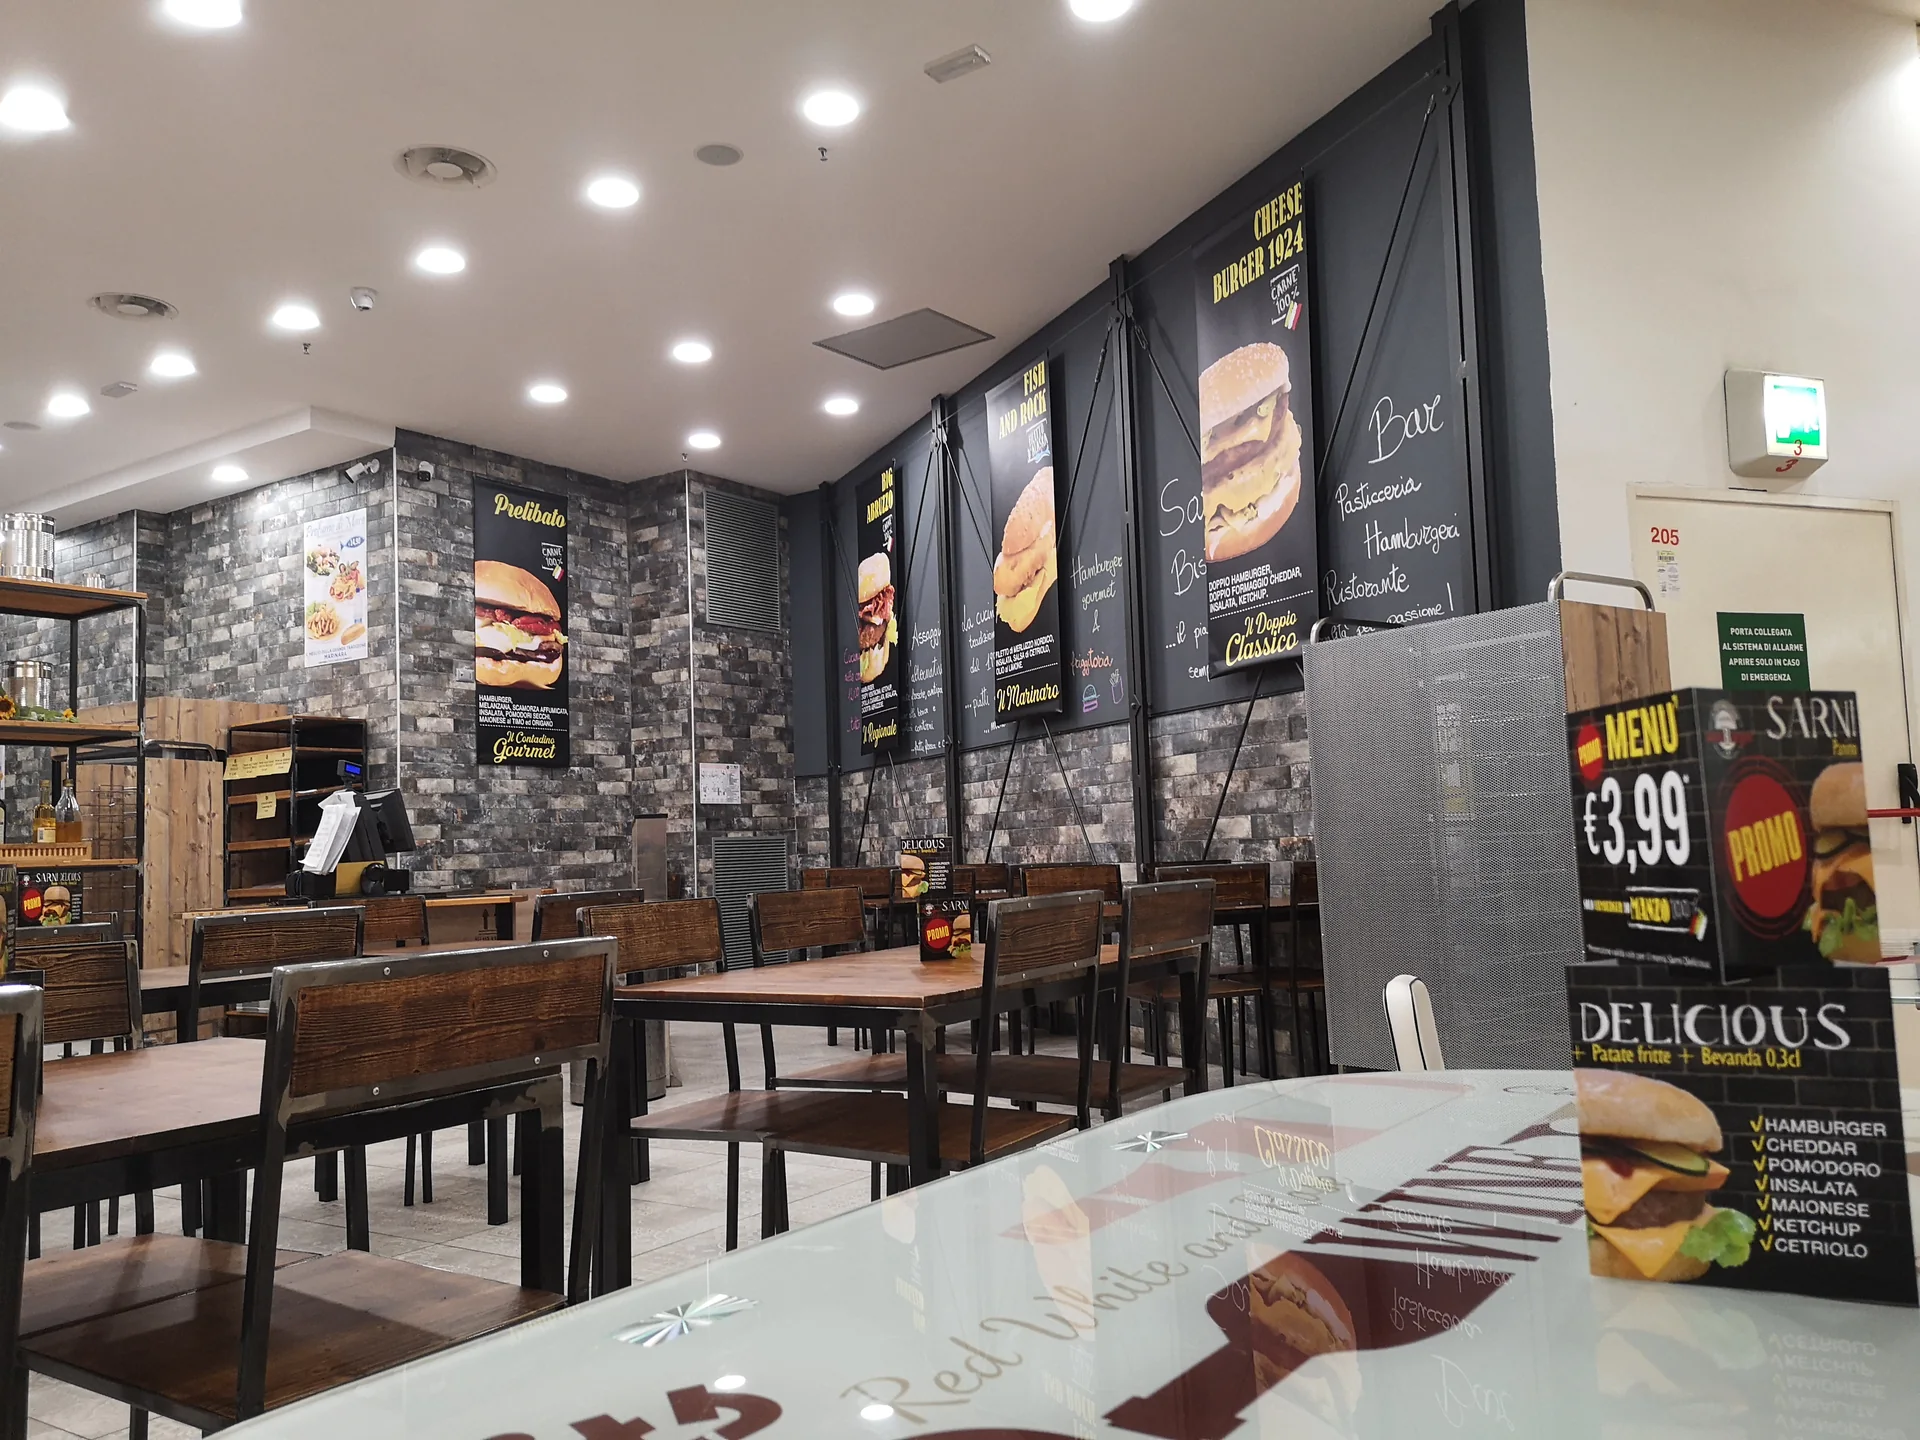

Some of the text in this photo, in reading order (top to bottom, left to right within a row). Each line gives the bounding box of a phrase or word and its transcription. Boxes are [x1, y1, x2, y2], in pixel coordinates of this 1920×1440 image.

[1254, 182, 1302, 240] CHEESE
[1213, 220, 1303, 304] BURGER 1924
[1271, 269, 1298, 300] CARNE
[1023, 361, 1046, 396] FISH
[999, 408, 1018, 440] AND
[1020, 388, 1047, 427] ROCK
[1368, 395, 1444, 463] Bar
[1793, 439, 1803, 455] 3
[1776, 458, 1798, 473] 3
[881, 467, 893, 492] BIG
[494, 493, 566, 528] Prelibato
[867, 490, 894, 524] ABRUZZO
[1159, 478, 1204, 536] Sa
[1335, 476, 1422, 521] Pasticceria
[1650, 526, 1679, 546] 205
[541, 547, 562, 556] CARNE
[1070, 553, 1122, 589] Hamburger
[1171, 549, 1207, 596] Bis
[1208, 564, 1272, 592] DOPPIO HAMBURGER,
[1209, 566, 1302, 602] DOPPIO FORMAGGIO CHEDDAR,
[1082, 580, 1116, 610] gourmet
[1323, 563, 1409, 610] Ristorante
[976, 601, 994, 625] cucin
[1209, 588, 1269, 614] INSALATA, KETCHUP.
[1386, 604, 1445, 624] passione
[1194, 623, 1208, 650] pia
[1244, 610, 1299, 637] Il Doppio
[1730, 627, 1792, 636] PORTA COLLEGATA
[969, 630, 995, 649] tradizion
[1225, 632, 1299, 667] Classico
[1722, 642, 1804, 652] AL SISTEMA DI ALLARME
[1729, 658, 1800, 667] APRIRE SOLO IN CASO
[1741, 673, 1791, 682] DI EMERGENZA
[479, 694, 513, 704] HAMBURGER,
[479, 702, 568, 716] MELANZANA, SCAMORZA AFFUMICATA,
[1007, 683, 1060, 711] Marinaro
[479, 709, 551, 721] INSALATA, POMODORI SECCHI,
[479, 716, 506, 724] MAIONESE
[512, 718, 524, 726] TIMO
[532, 719, 553, 727] ORIGANO
[1766, 695, 1857, 740] SARNI
[506, 730, 555, 745] Il Contadino
[868, 718, 897, 748] Regionale
[493, 737, 556, 764] Gourmet
[901, 838, 945, 850] DELICIOUS
[1727, 811, 1802, 882] PROMO
[941, 900, 970, 912] SARNI
[926, 925, 949, 942] PROMO
[1579, 1002, 1851, 1050] DELICIOUS
[1591, 1044, 1634, 1063] Patate
[1637, 1046, 1672, 1065] fritte
[1701, 1047, 1762, 1067] Bevanda
[1766, 1048, 1801, 1070] 0,3cl
[1765, 1118, 1887, 1137] HAMBURGER
[1766, 1138, 1858, 1156] CHEDDAR
[1768, 1158, 1881, 1177] POMODORO
[1770, 1178, 1858, 1197] INSALATA
[1771, 1198, 1870, 1218] MAIONESE
[1773, 1218, 1861, 1237] KETCHUP
[1774, 1238, 1868, 1258] CETRIOLO
[840, 1336, 1023, 1425] Red
[979, 1260, 1189, 1341] White
